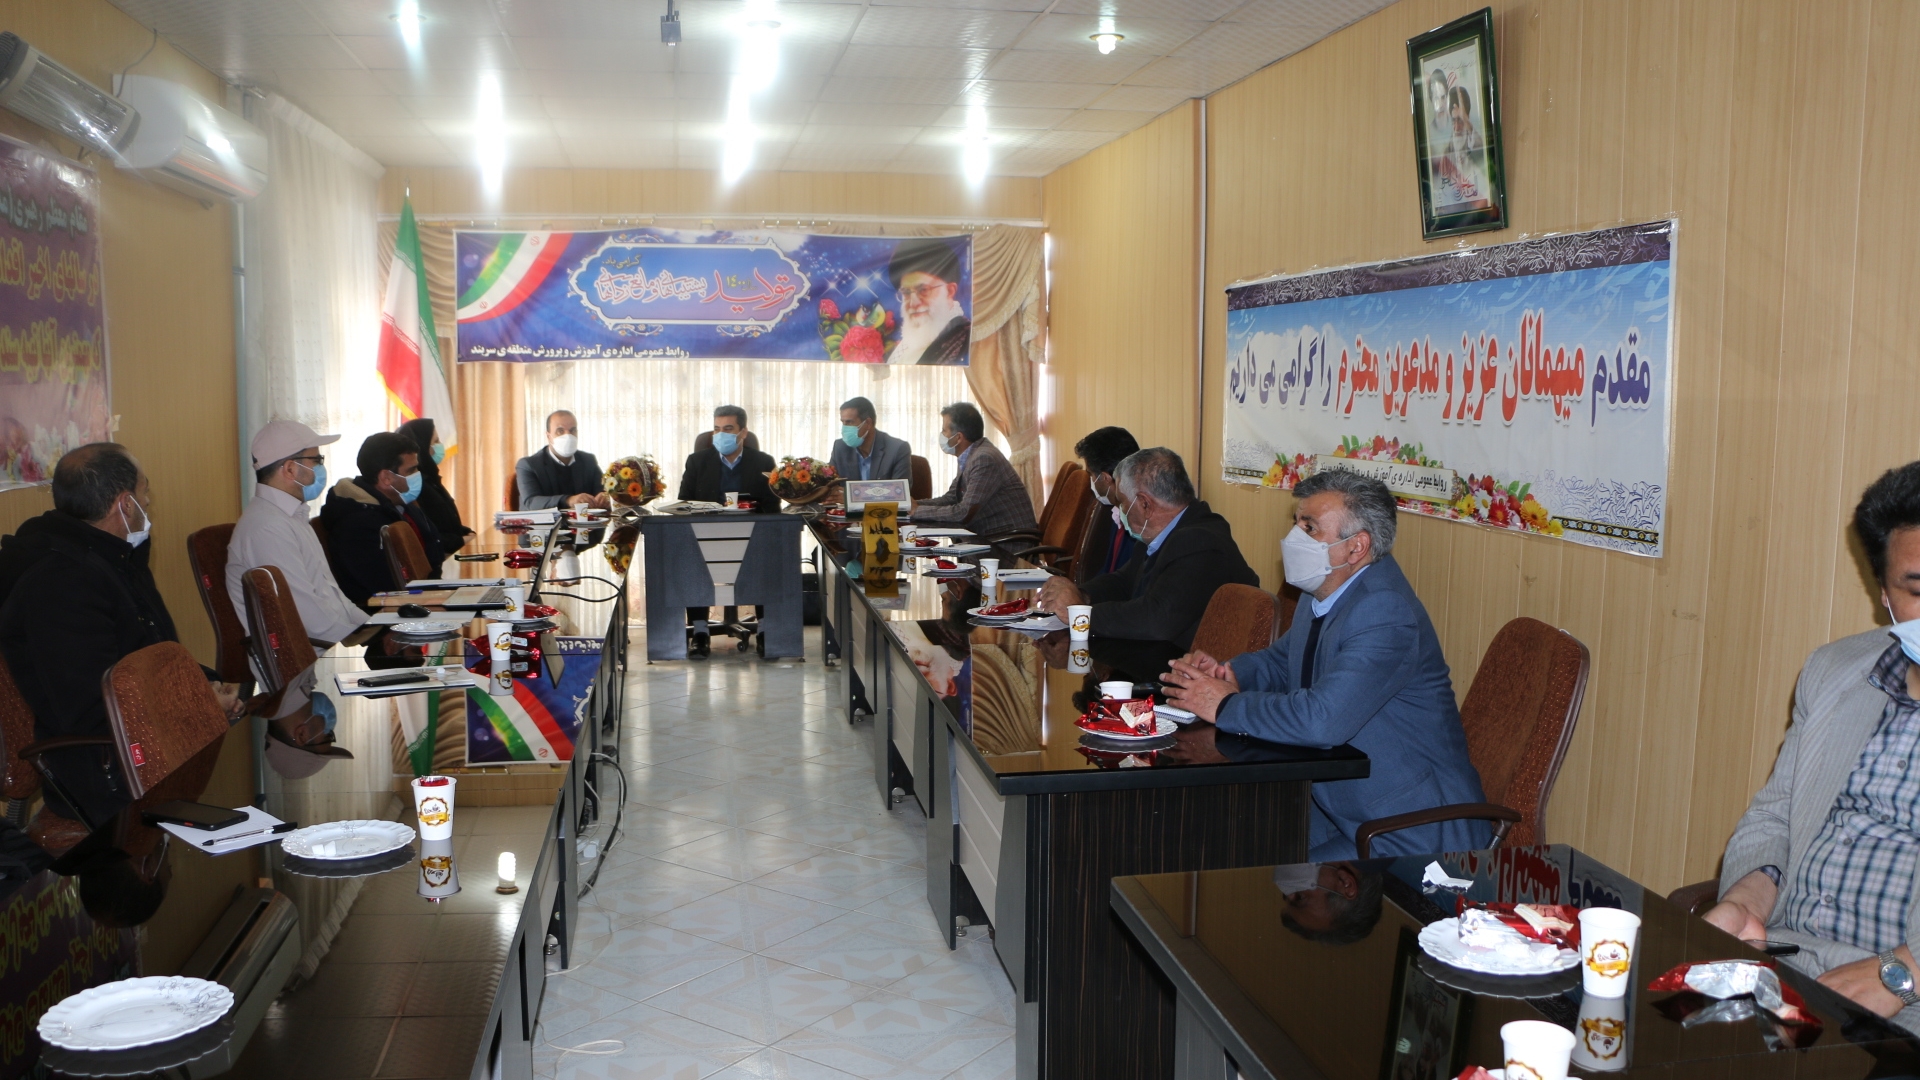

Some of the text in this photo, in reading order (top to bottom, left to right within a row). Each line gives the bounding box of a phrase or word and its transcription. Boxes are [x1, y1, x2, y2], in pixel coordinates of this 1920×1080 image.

[533, 345, 563, 358] پرورش
[570, 344, 601, 357] آموزش
[634, 348, 664, 358] عمومی
[665, 346, 690, 358] روابط
[1229, 307, 1651, 428] مقدم میهمانان عزیز و مدعوین محترم را گرامی می داریم
[1415, 474, 1433, 489] عمومی
[1433, 474, 1447, 493] روابط
